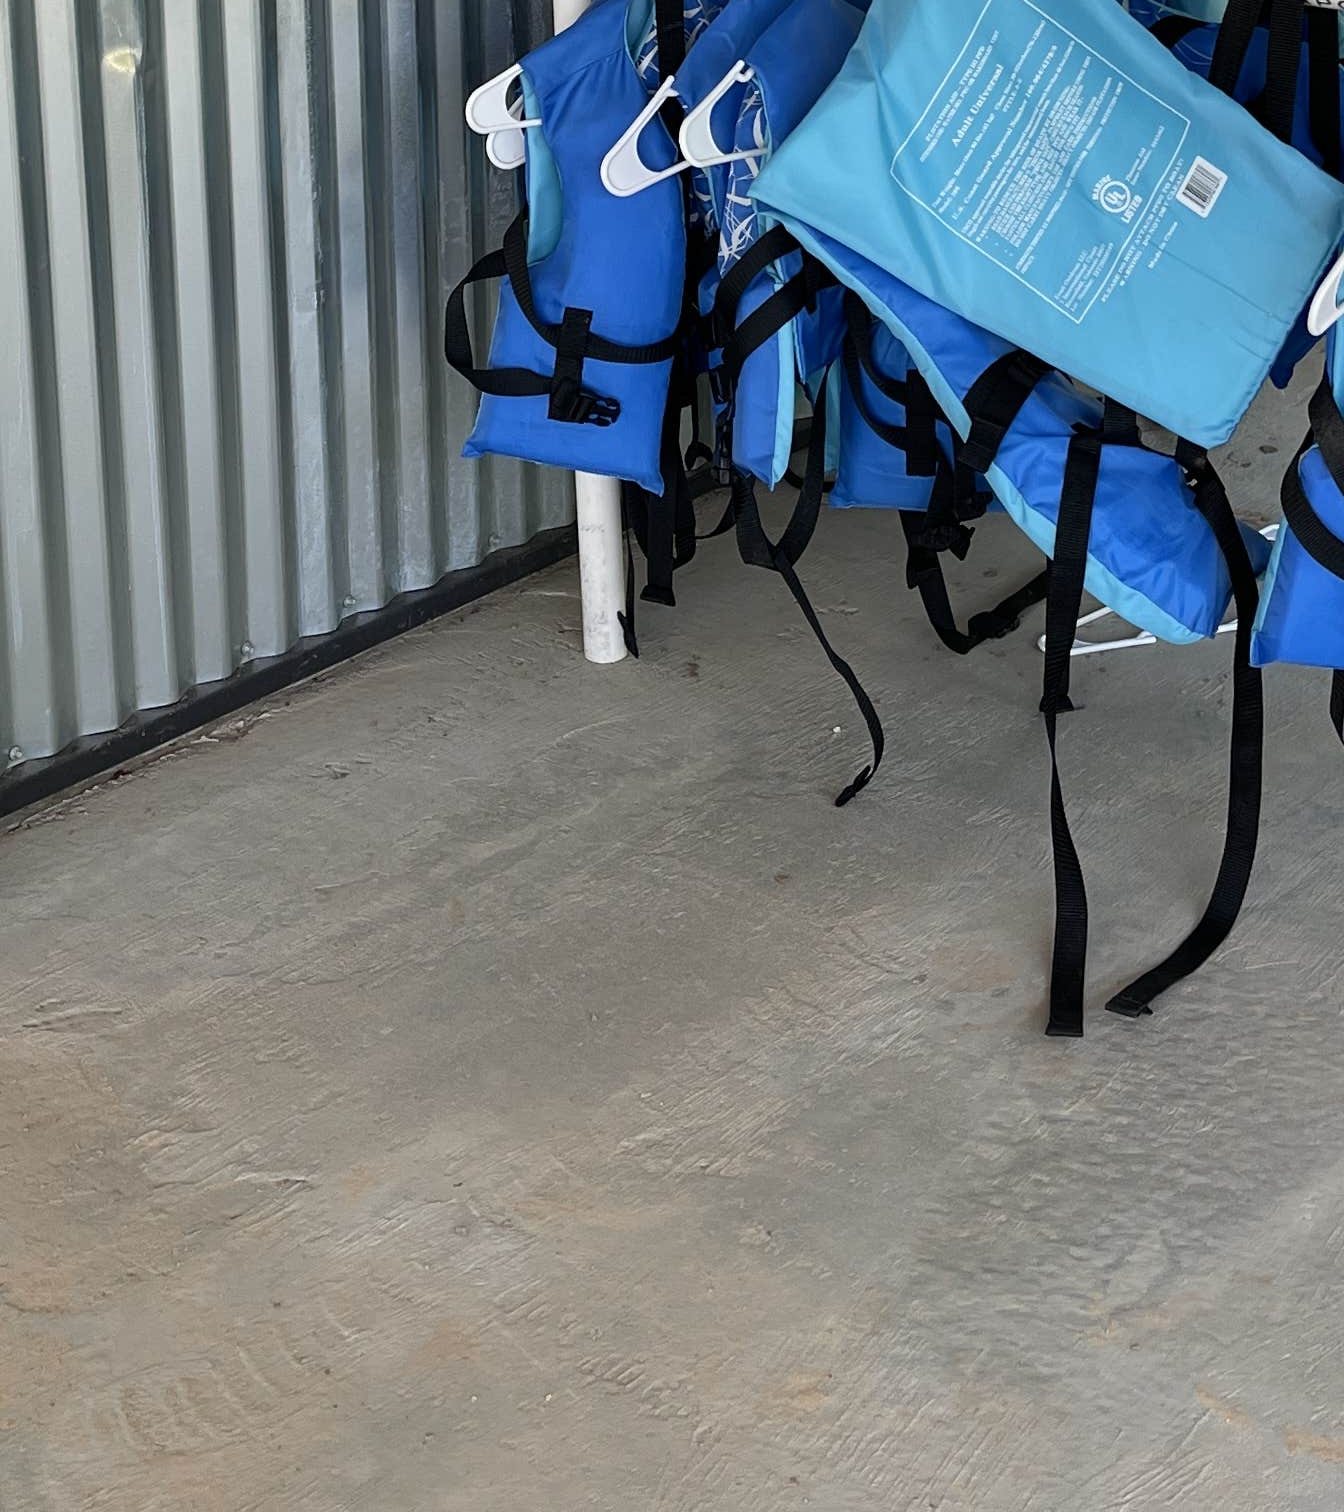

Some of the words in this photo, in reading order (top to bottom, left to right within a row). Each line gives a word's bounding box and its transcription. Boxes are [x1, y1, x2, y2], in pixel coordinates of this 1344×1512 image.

[949, 112, 975, 148] Adult
[968, 61, 1005, 117] Universal
[1120, 191, 1144, 225] LISTED
